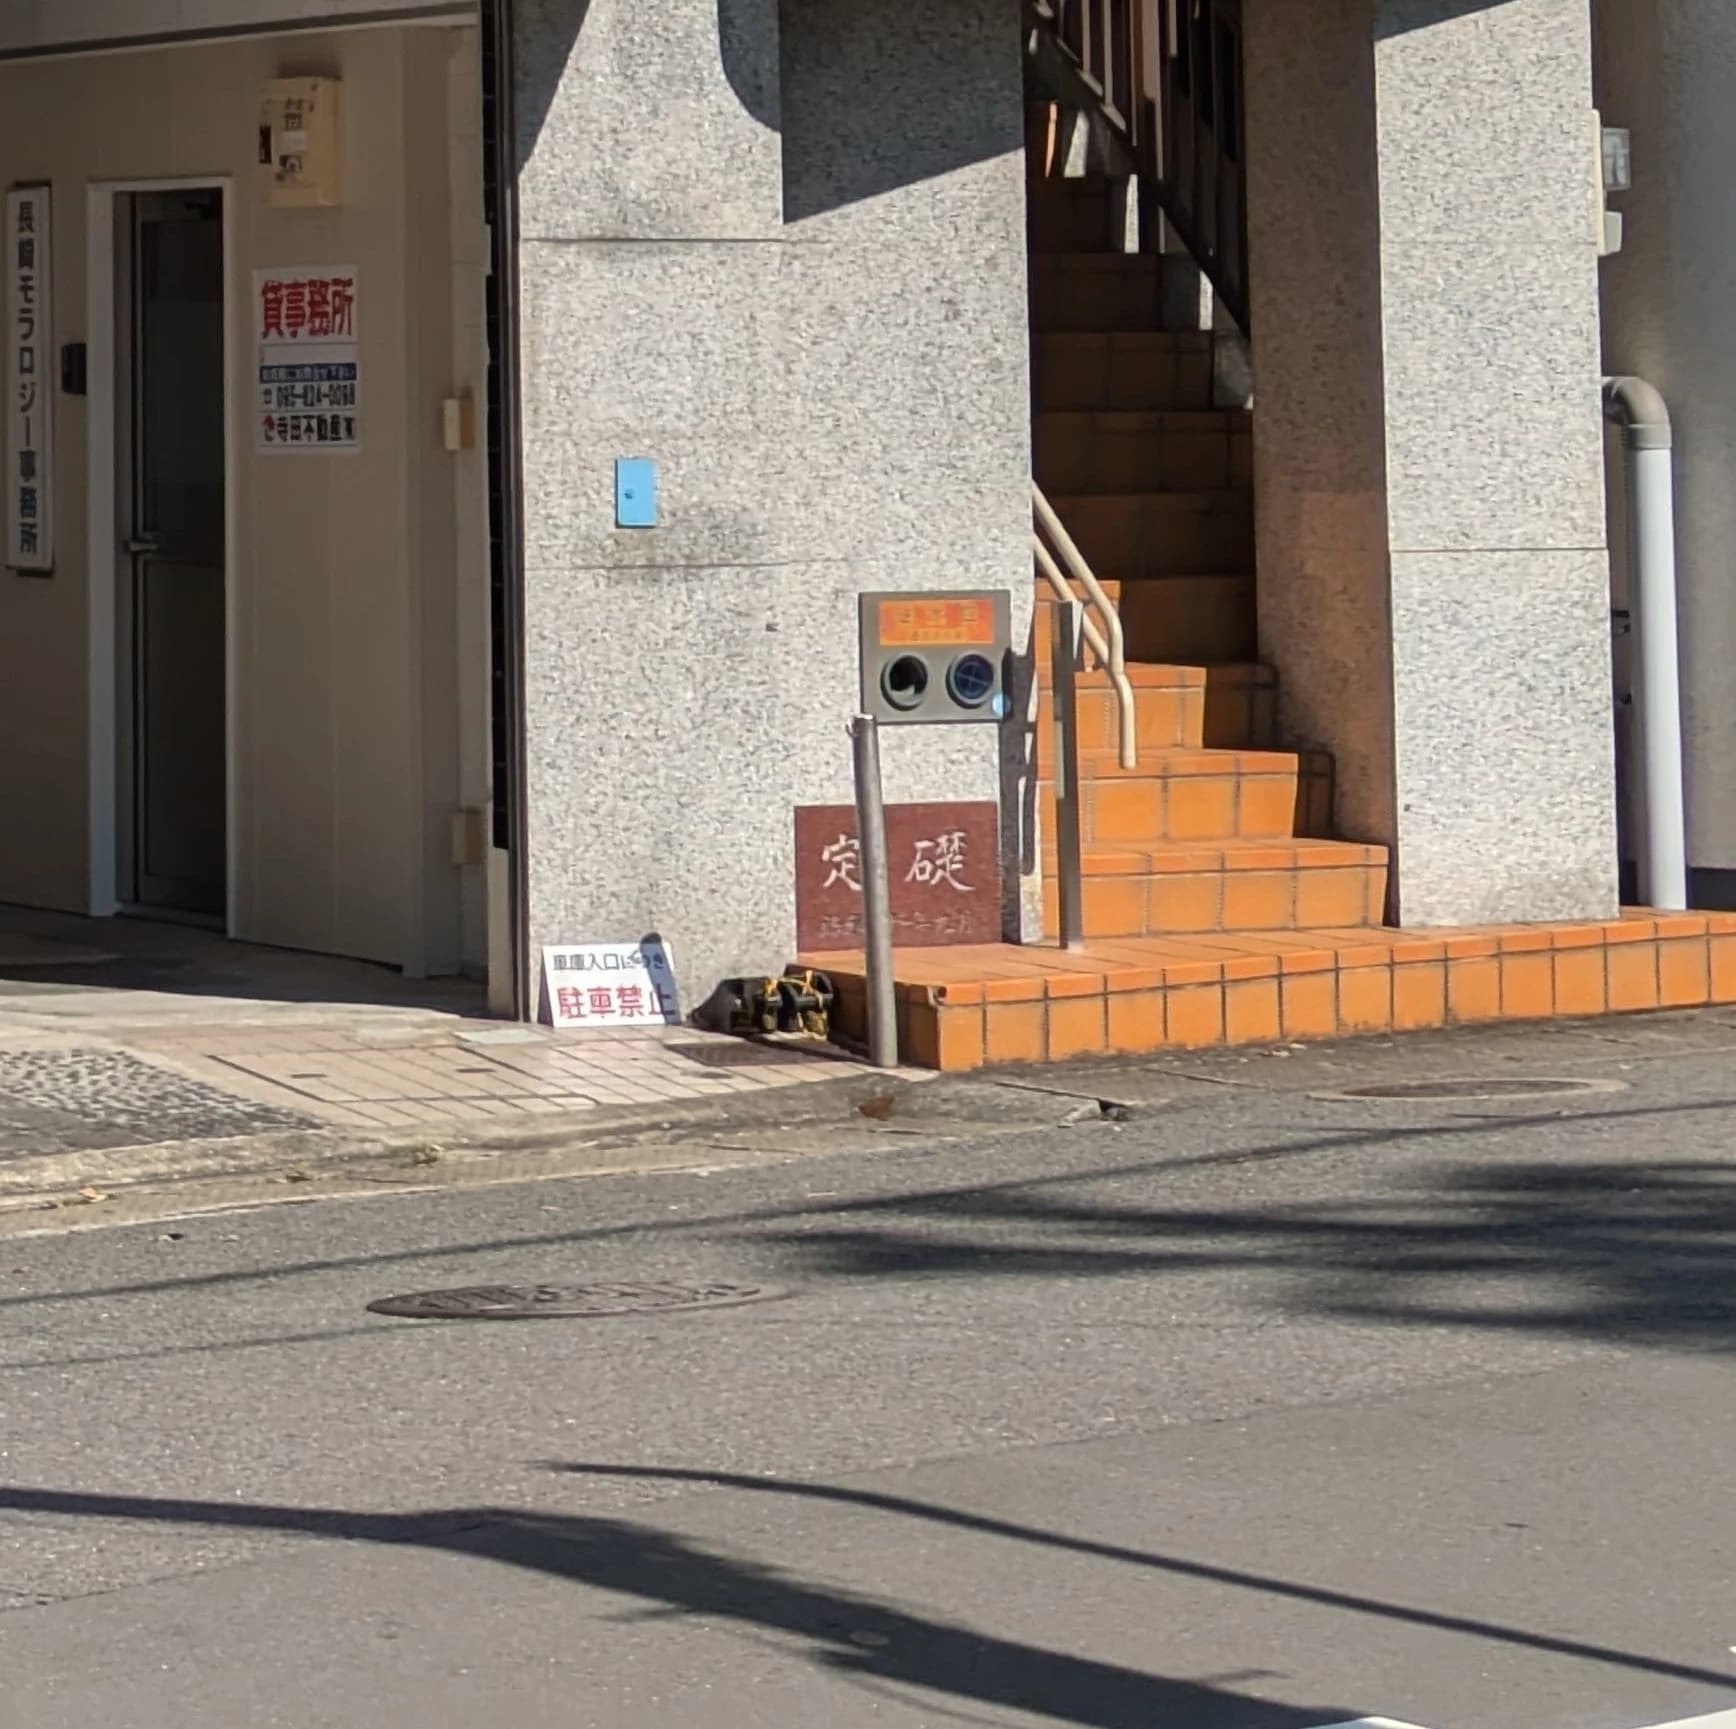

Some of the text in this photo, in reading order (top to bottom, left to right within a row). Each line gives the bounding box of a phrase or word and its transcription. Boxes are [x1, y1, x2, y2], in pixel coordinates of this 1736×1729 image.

[260, 278, 355, 339] 貸事務所
[820, 825, 977, 892] 定礎
[557, 982, 677, 1020] 駐車禁止
